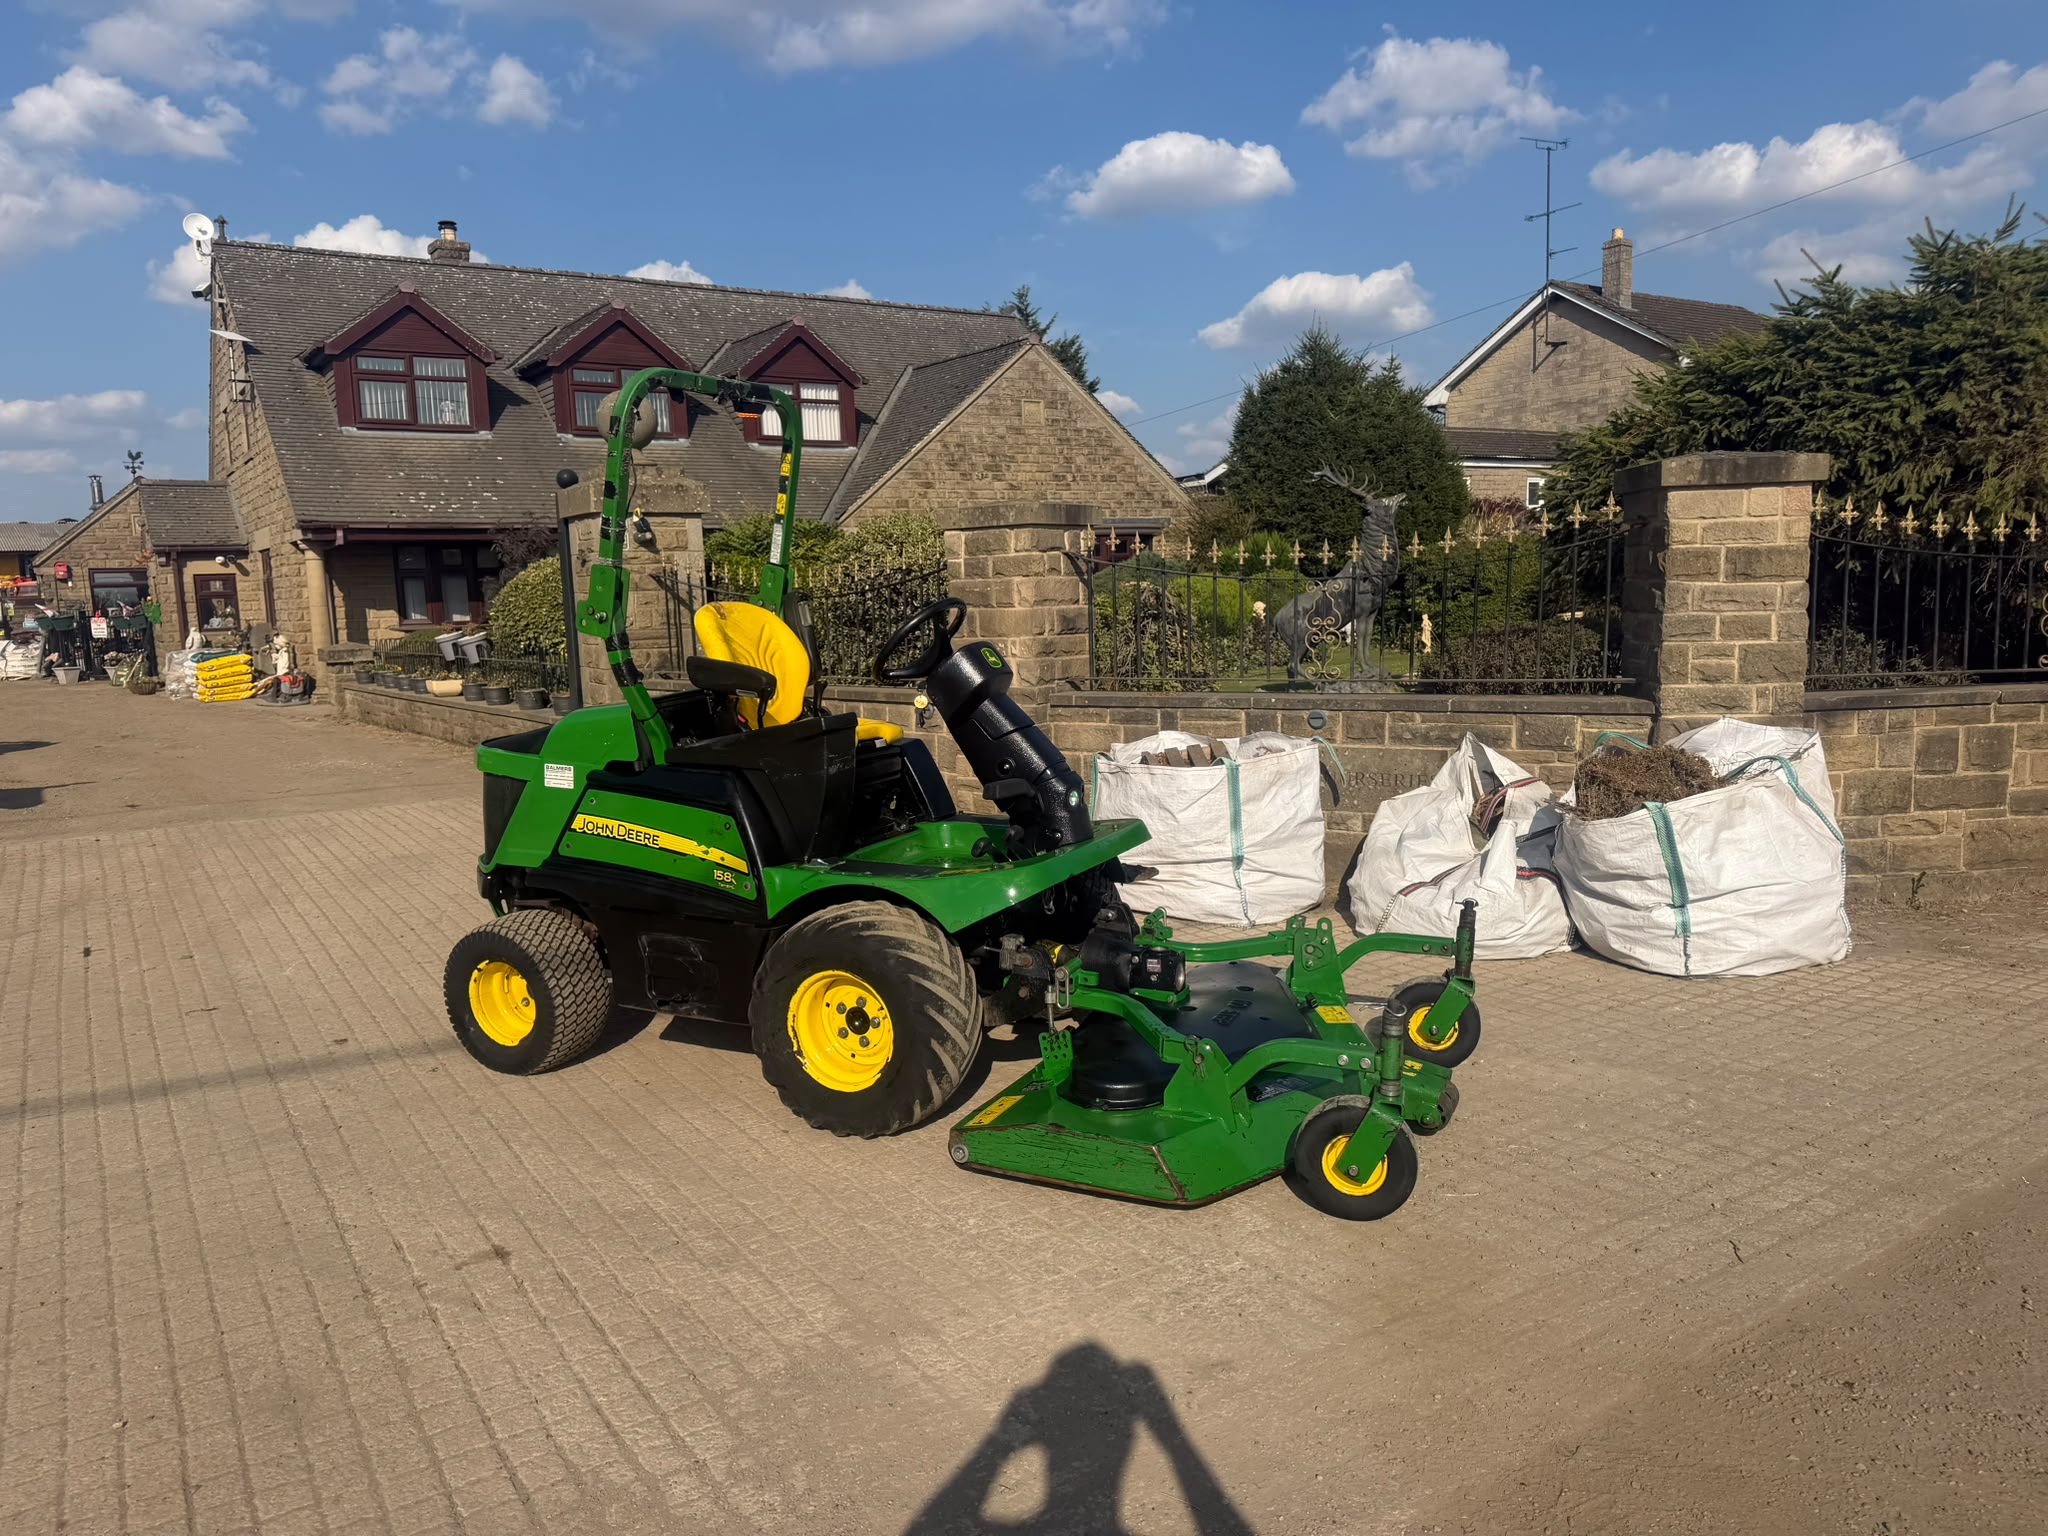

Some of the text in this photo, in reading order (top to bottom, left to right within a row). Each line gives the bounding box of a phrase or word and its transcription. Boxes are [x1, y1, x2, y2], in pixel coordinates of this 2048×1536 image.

[545, 764, 572, 772] BALMERS
[1335, 770, 1437, 789] RSERIE
[578, 817, 661, 847] JOHN DEERE
